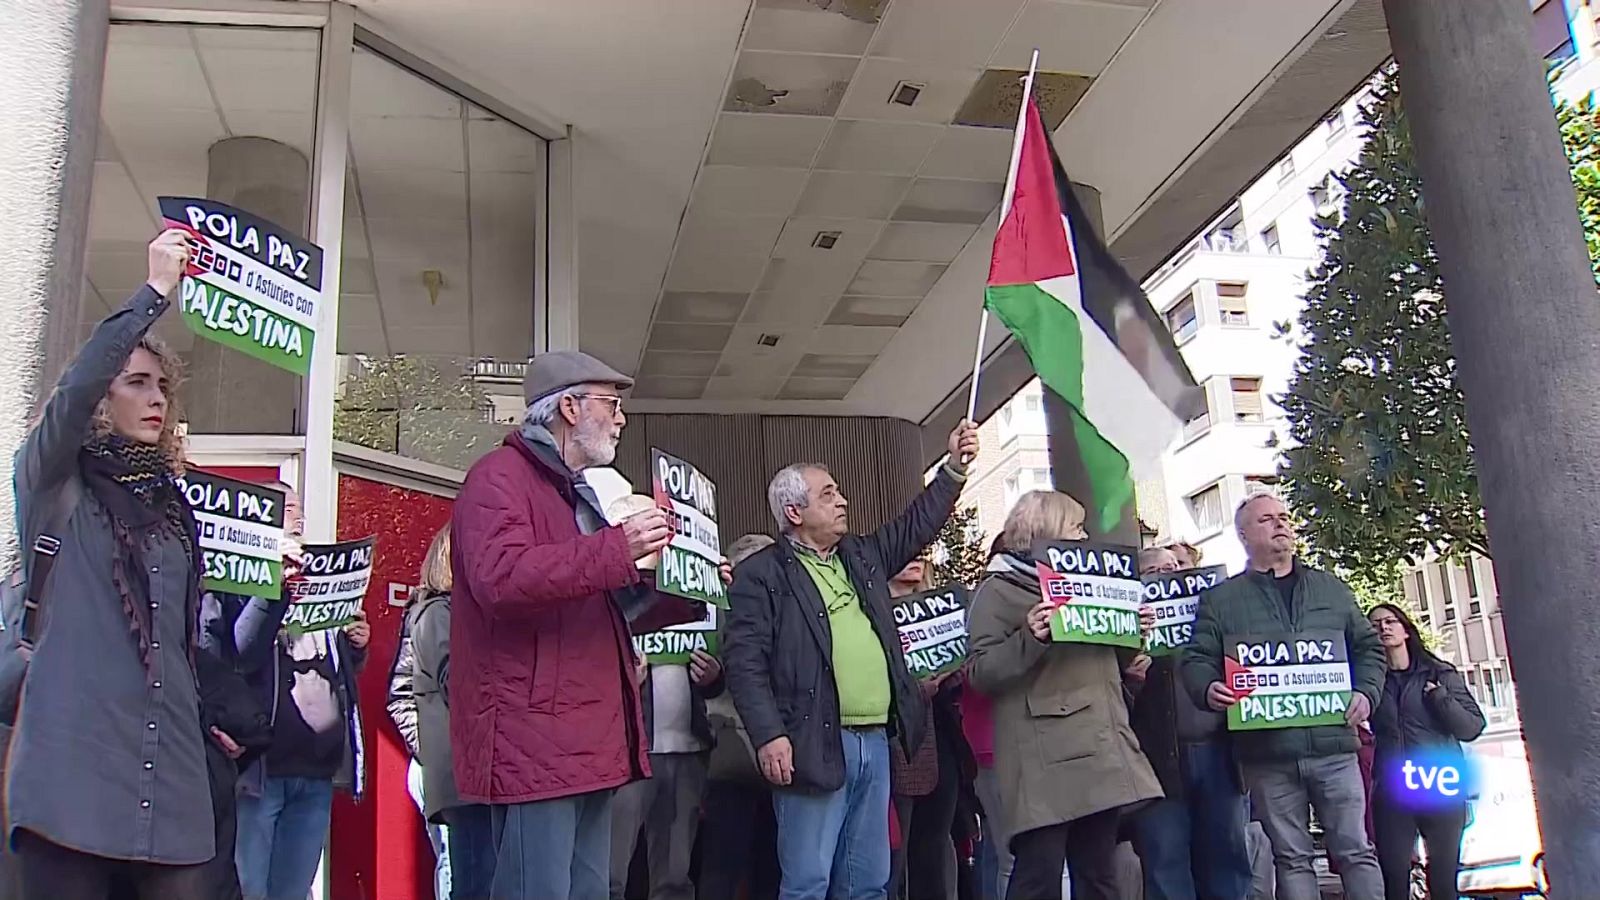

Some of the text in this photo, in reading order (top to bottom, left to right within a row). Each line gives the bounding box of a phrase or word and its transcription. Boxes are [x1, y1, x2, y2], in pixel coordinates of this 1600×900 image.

[186, 206, 310, 280] POLA PAZ
[181, 276, 303, 356] PALESTINA
[296, 293, 314, 316] con
[659, 456, 697, 500] POLA
[238, 491, 274, 522] PAZ
[263, 536, 278, 550] con
[301, 546, 371, 573] POLA PAZ
[662, 545, 723, 597] PALESTINA
[1047, 547, 1132, 577] POLA PAZ
[925, 592, 960, 617] PAZ
[1059, 604, 1137, 636] PALESTINA
[1236, 640, 1334, 666] POLA PAZ
[1329, 671, 1345, 684] con
[1239, 692, 1346, 722] PALESTINA
